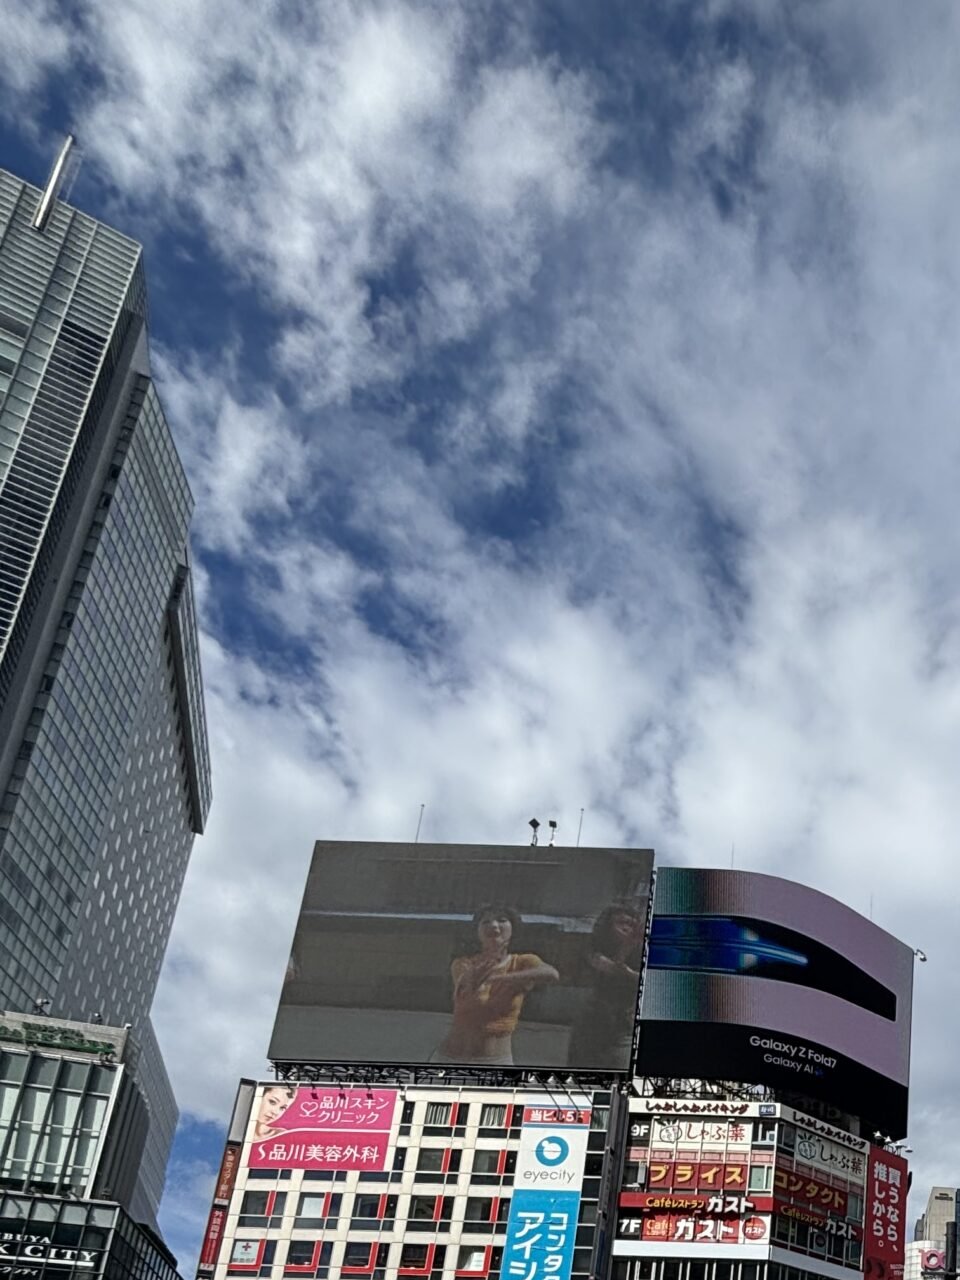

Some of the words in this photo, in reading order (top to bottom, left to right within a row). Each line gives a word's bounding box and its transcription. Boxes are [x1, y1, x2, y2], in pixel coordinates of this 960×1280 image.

[749, 1035, 797, 1057] Galaxy
[799, 1046, 807, 1058] Z
[808, 1049, 837, 1069] Fold7
[763, 1053, 803, 1073] Galaxy
[804, 1064, 814, 1074] AI
[319, 1095, 390, 1110] 品川スキン
[317, 1110, 380, 1124] クリニック
[630, 1124, 650, 1137] 9F
[686, 1123, 746, 1143] しゃぶ葉
[268, 1143, 380, 1163] 品川美容外科
[820, 1143, 863, 1175] しゃぶ葉
[523, 1169, 576, 1184] eyecity
[650, 1164, 745, 1185] プライス
[775, 1170, 845, 1209] コンタクト
[706, 1195, 754, 1213] ガスト
[872, 1160, 888, 1248] 推しから。
[887, 1166, 902, 1252] 買うなら、
[619, 1218, 642, 1233] 7F
[674, 1217, 734, 1240] ガスト
[745, 1226, 765, 1234] ガスト
[825, 1216, 858, 1240] ガスト
[0, 1232, 52, 1244] BUYA
[24, 1245, 98, 1261] CITY
